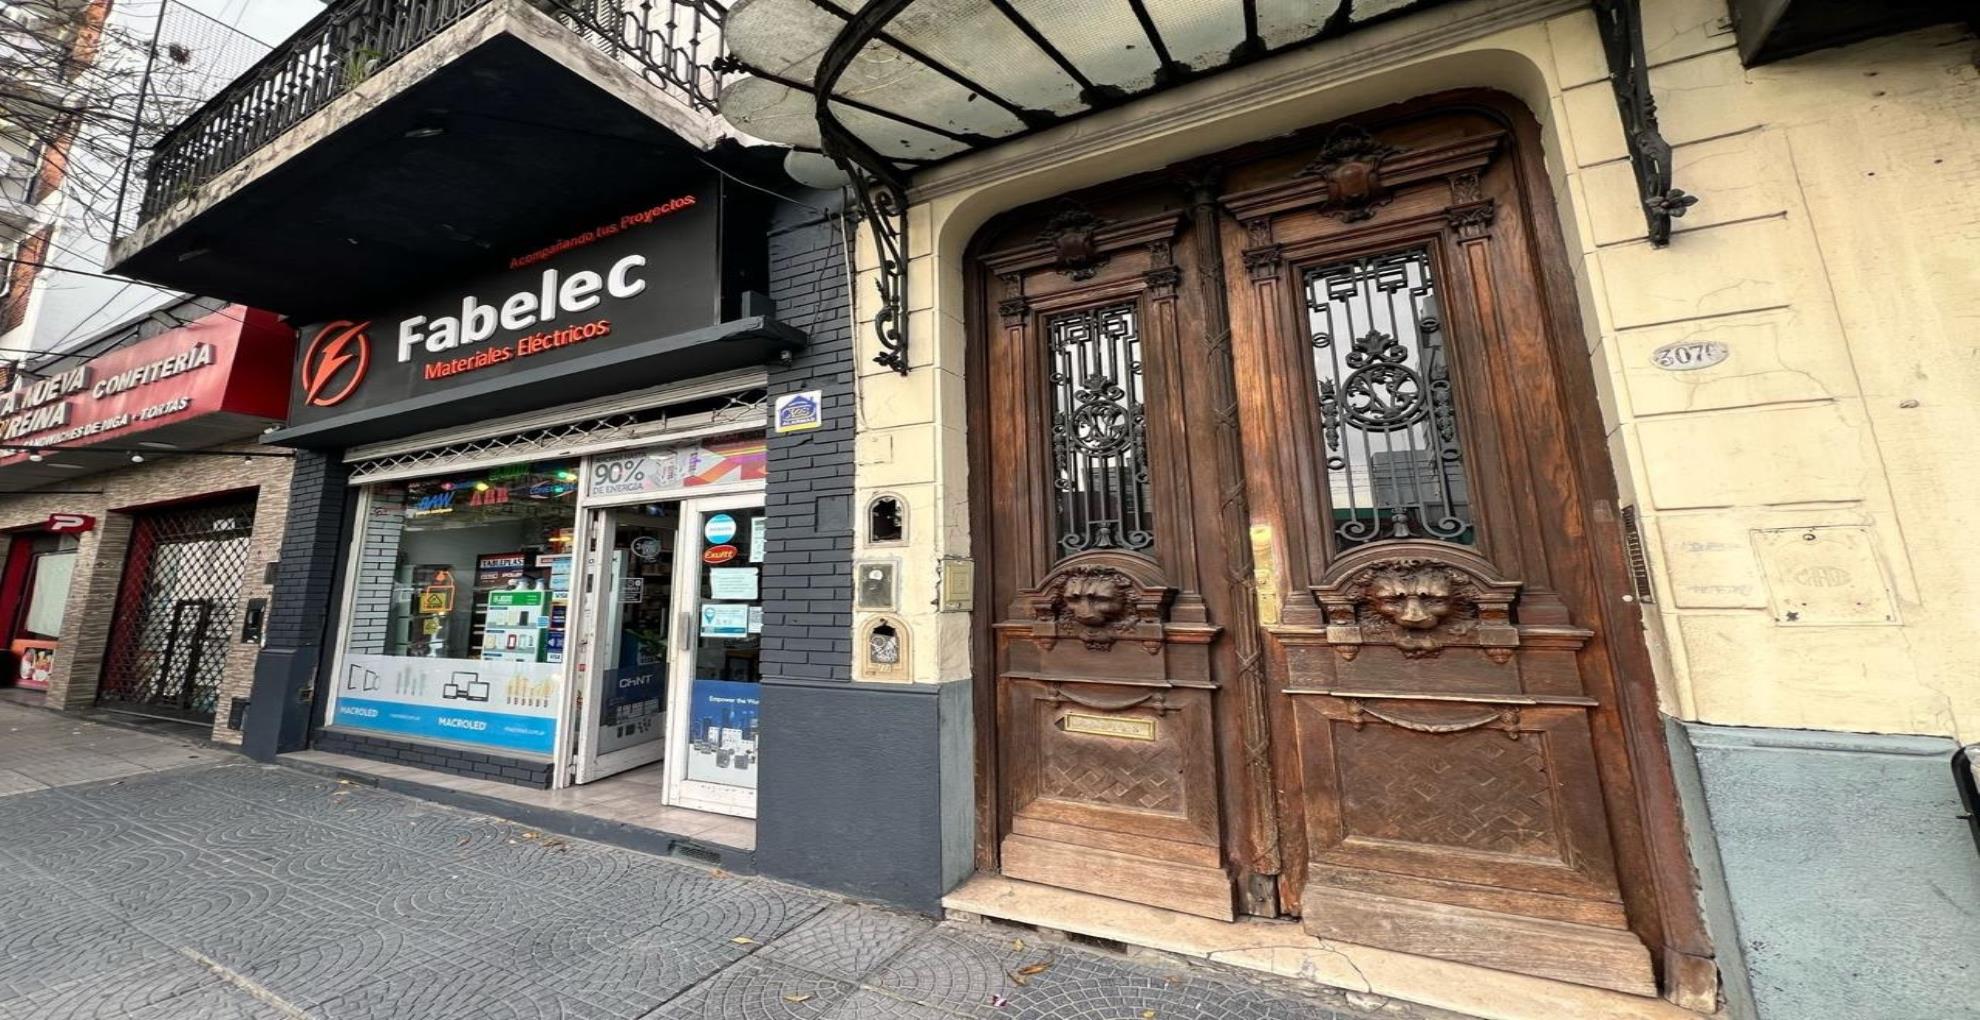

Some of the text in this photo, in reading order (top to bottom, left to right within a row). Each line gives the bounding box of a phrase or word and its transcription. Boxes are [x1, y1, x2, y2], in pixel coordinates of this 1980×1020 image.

[510, 195, 696, 268] Acompañando tus Proyectos
[398, 254, 646, 362] Fabelec
[425, 320, 611, 379] Materiales Eléctricos
[21, 365, 87, 409] NUEVA
[4, 401, 67, 440] REINA
[140, 397, 190, 420] TORTAS
[594, 458, 645, 486] 90%
[592, 486, 604, 495] DE
[340, 706, 379, 717] MACROLED
[438, 717, 487, 730] MACROLED
